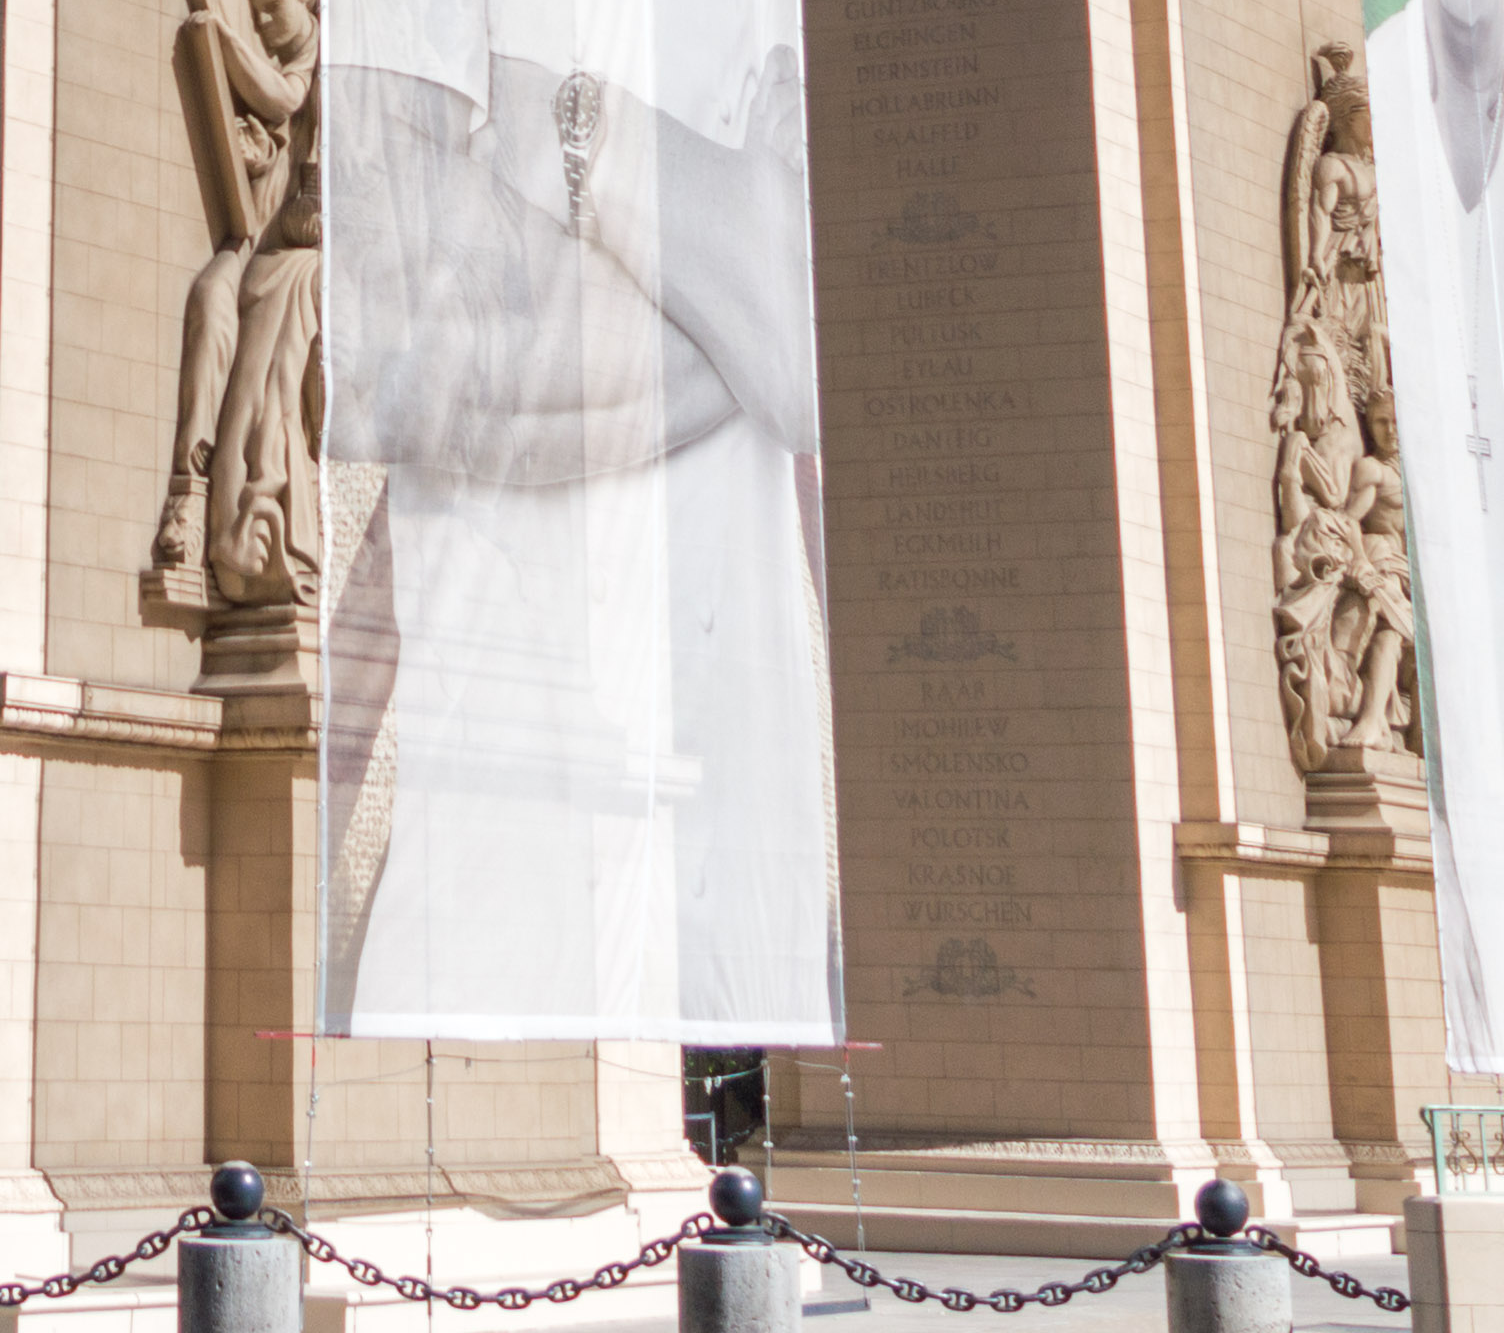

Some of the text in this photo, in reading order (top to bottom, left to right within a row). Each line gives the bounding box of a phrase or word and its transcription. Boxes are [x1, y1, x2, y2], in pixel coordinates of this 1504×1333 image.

[856, 54, 980, 85] DIERNSTEIN
[850, 86, 1000, 119] HOLLABRUNN
[902, 356, 974, 381] EYLAU
[901, 900, 1032, 925] WURSCHEN
